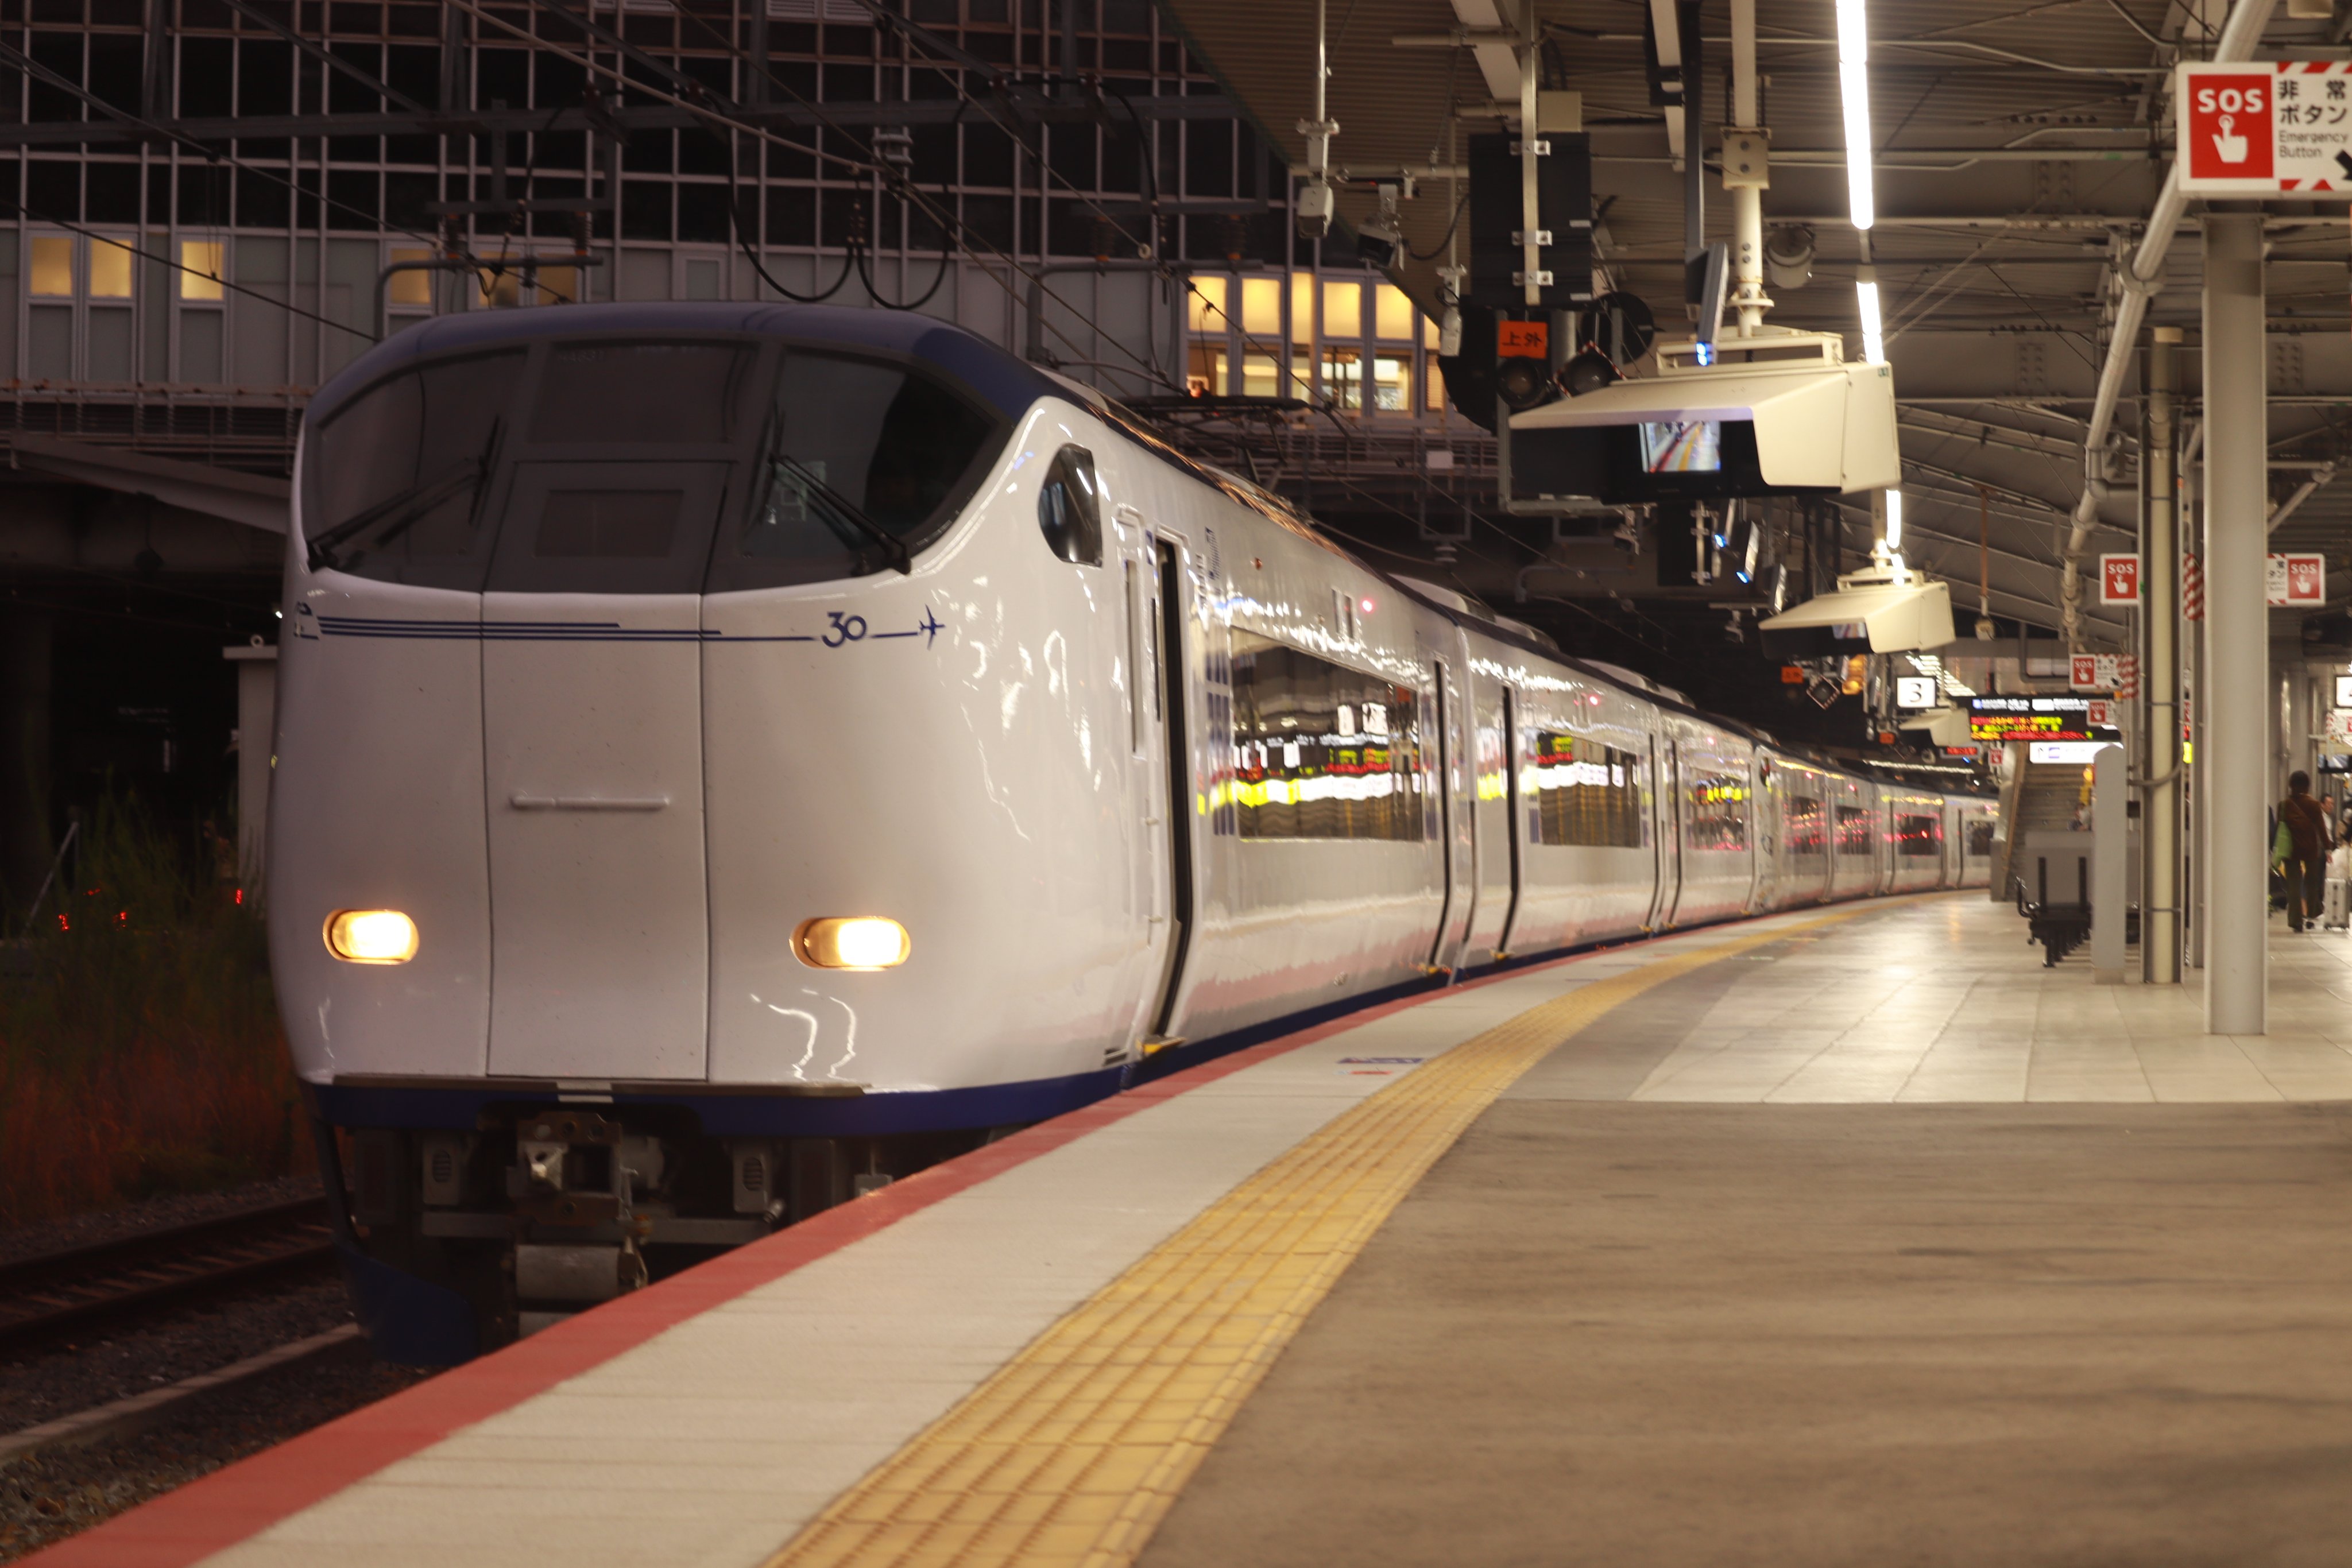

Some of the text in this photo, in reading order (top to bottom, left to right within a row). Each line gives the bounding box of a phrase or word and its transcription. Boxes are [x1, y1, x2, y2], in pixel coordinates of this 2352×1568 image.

[2278, 80, 2346, 100] 非常
[2197, 88, 2264, 113] SOS
[2280, 104, 2347, 125] ボタン
[2278, 130, 2348, 144] Emergency
[2278, 145, 2322, 158] Button
[2107, 563, 2134, 575] SOS
[2290, 563, 2317, 575] SOS
[822, 611, 867, 648] 30
[1909, 682, 1922, 703] 3
